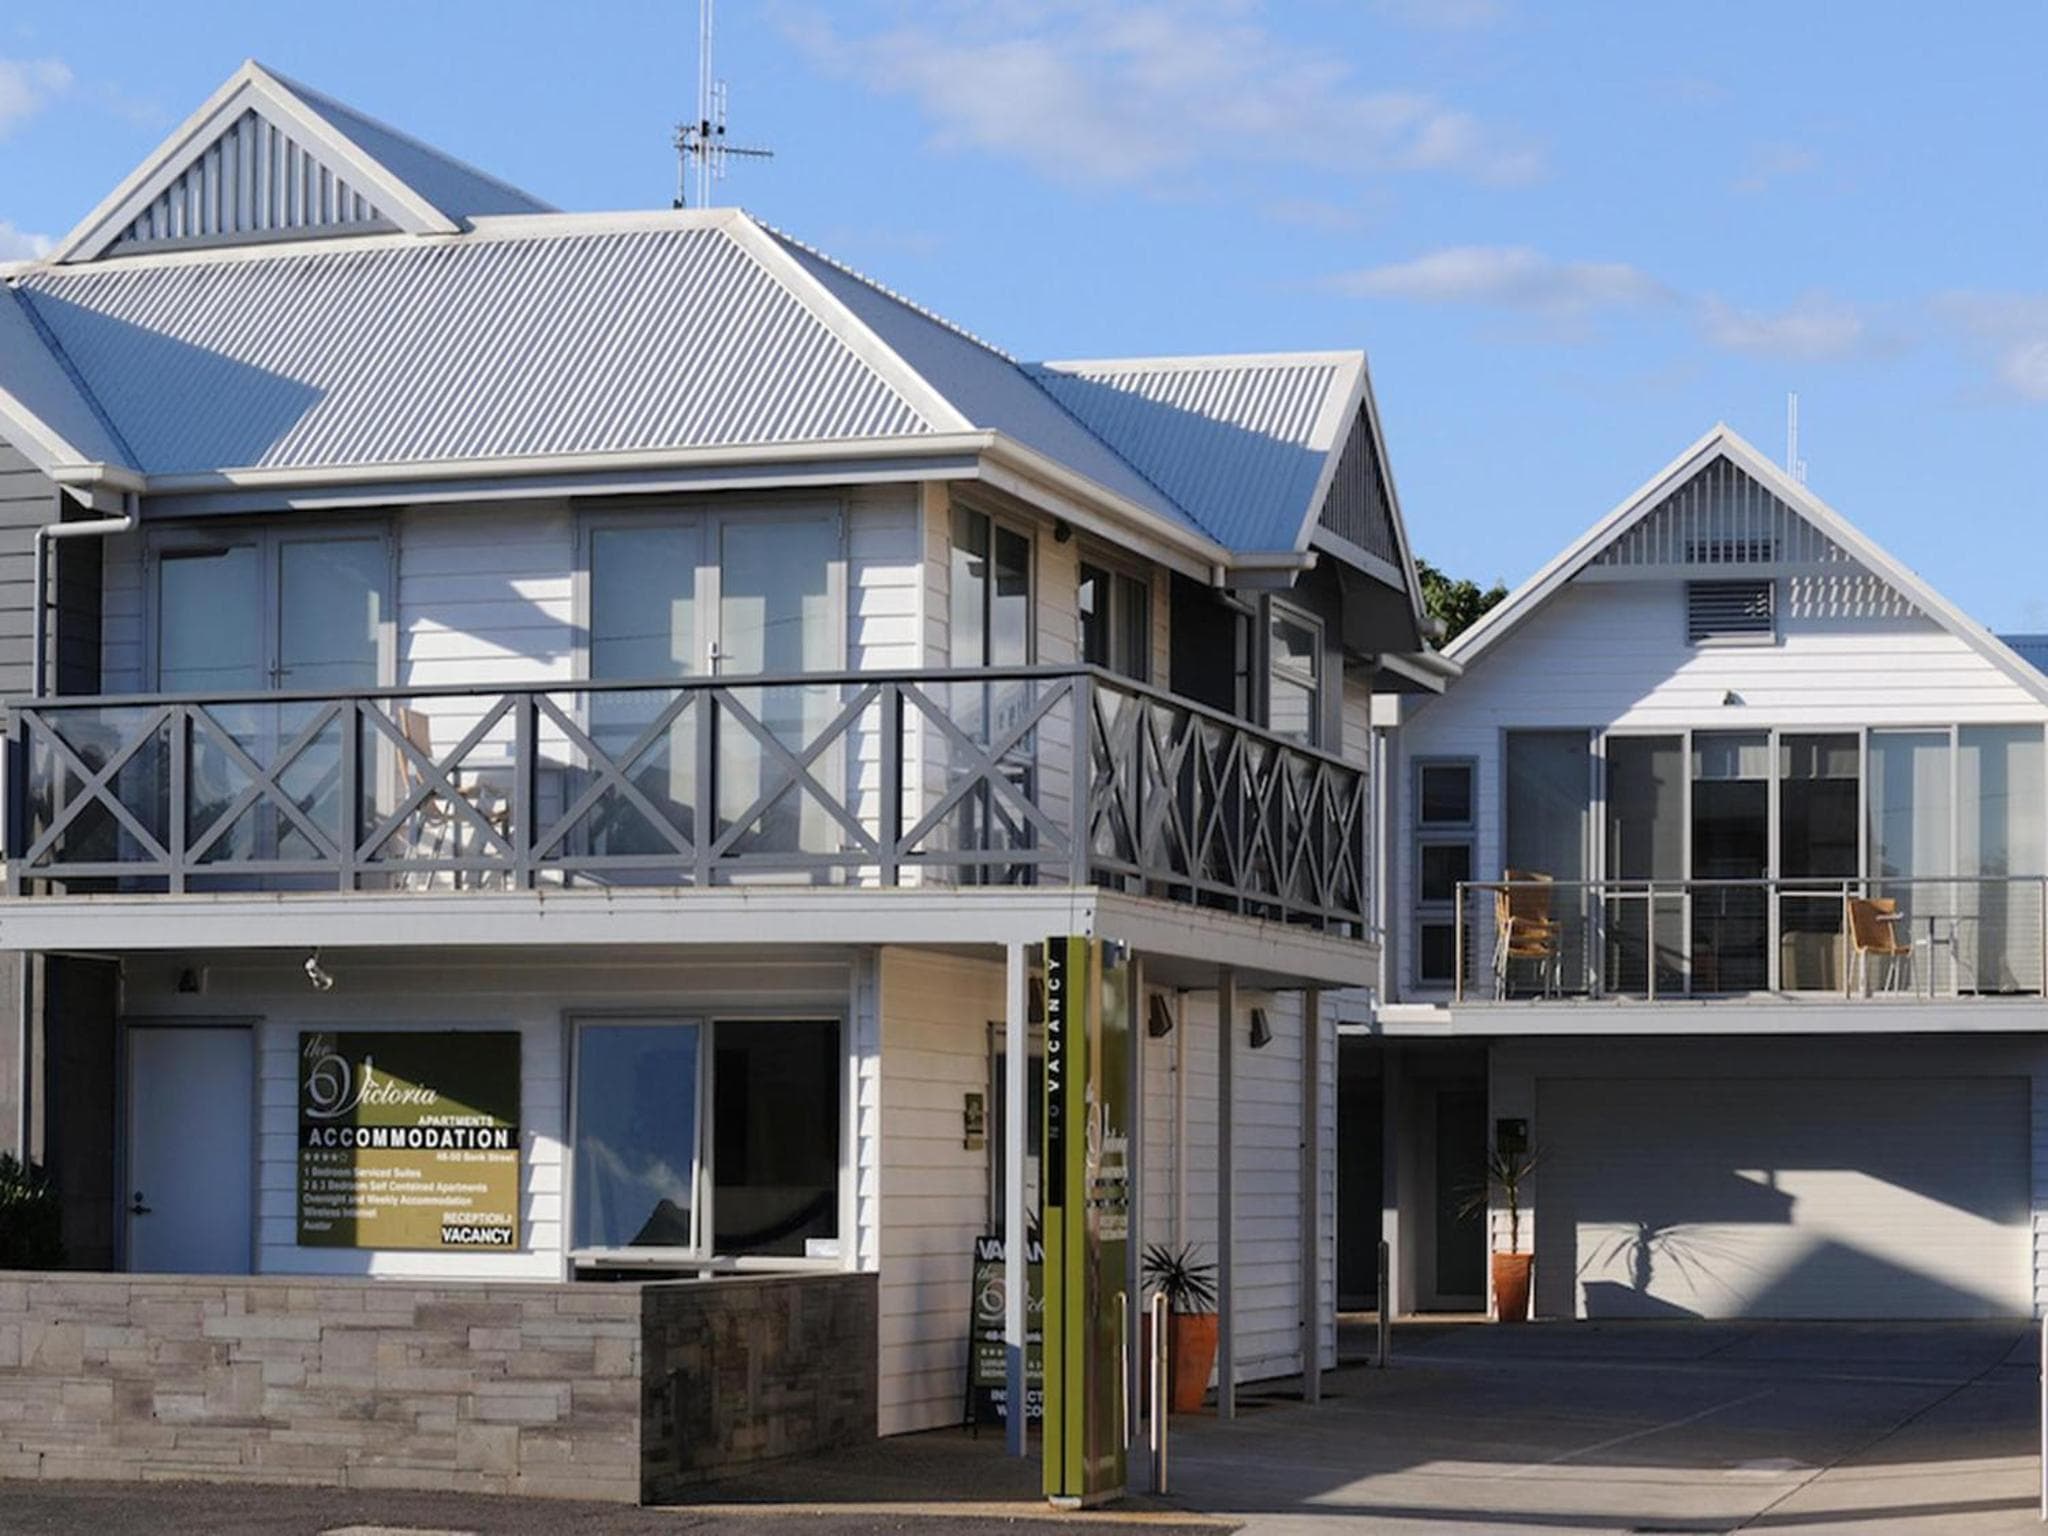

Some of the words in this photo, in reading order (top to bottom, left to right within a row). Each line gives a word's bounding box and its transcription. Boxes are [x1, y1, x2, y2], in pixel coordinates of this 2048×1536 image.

[1048, 959, 1061, 1092] VACANCY
[304, 1054, 439, 1118] Victoria
[417, 1115, 494, 1126] APARTMENTS
[309, 1128, 508, 1147] ACCOMMODATION
[488, 1152, 515, 1162] Street
[311, 1167, 352, 1177] Bedroom
[354, 1168, 392, 1178] Serviced
[393, 1167, 422, 1178] Suites
[328, 1181, 368, 1191] Bedroom
[370, 1180, 387, 1191] Self
[389, 1181, 434, 1192] Contained
[436, 1182, 487, 1194] Apartments
[303, 1193, 346, 1206] Overnight
[347, 1195, 365, 1205] and
[367, 1195, 398, 1207] Weekly
[400, 1195, 473, 1206] Accommodation
[303, 1207, 341, 1218] Wireless
[343, 1207, 378, 1218] Internet
[442, 1227, 511, 1243] VACANCY
